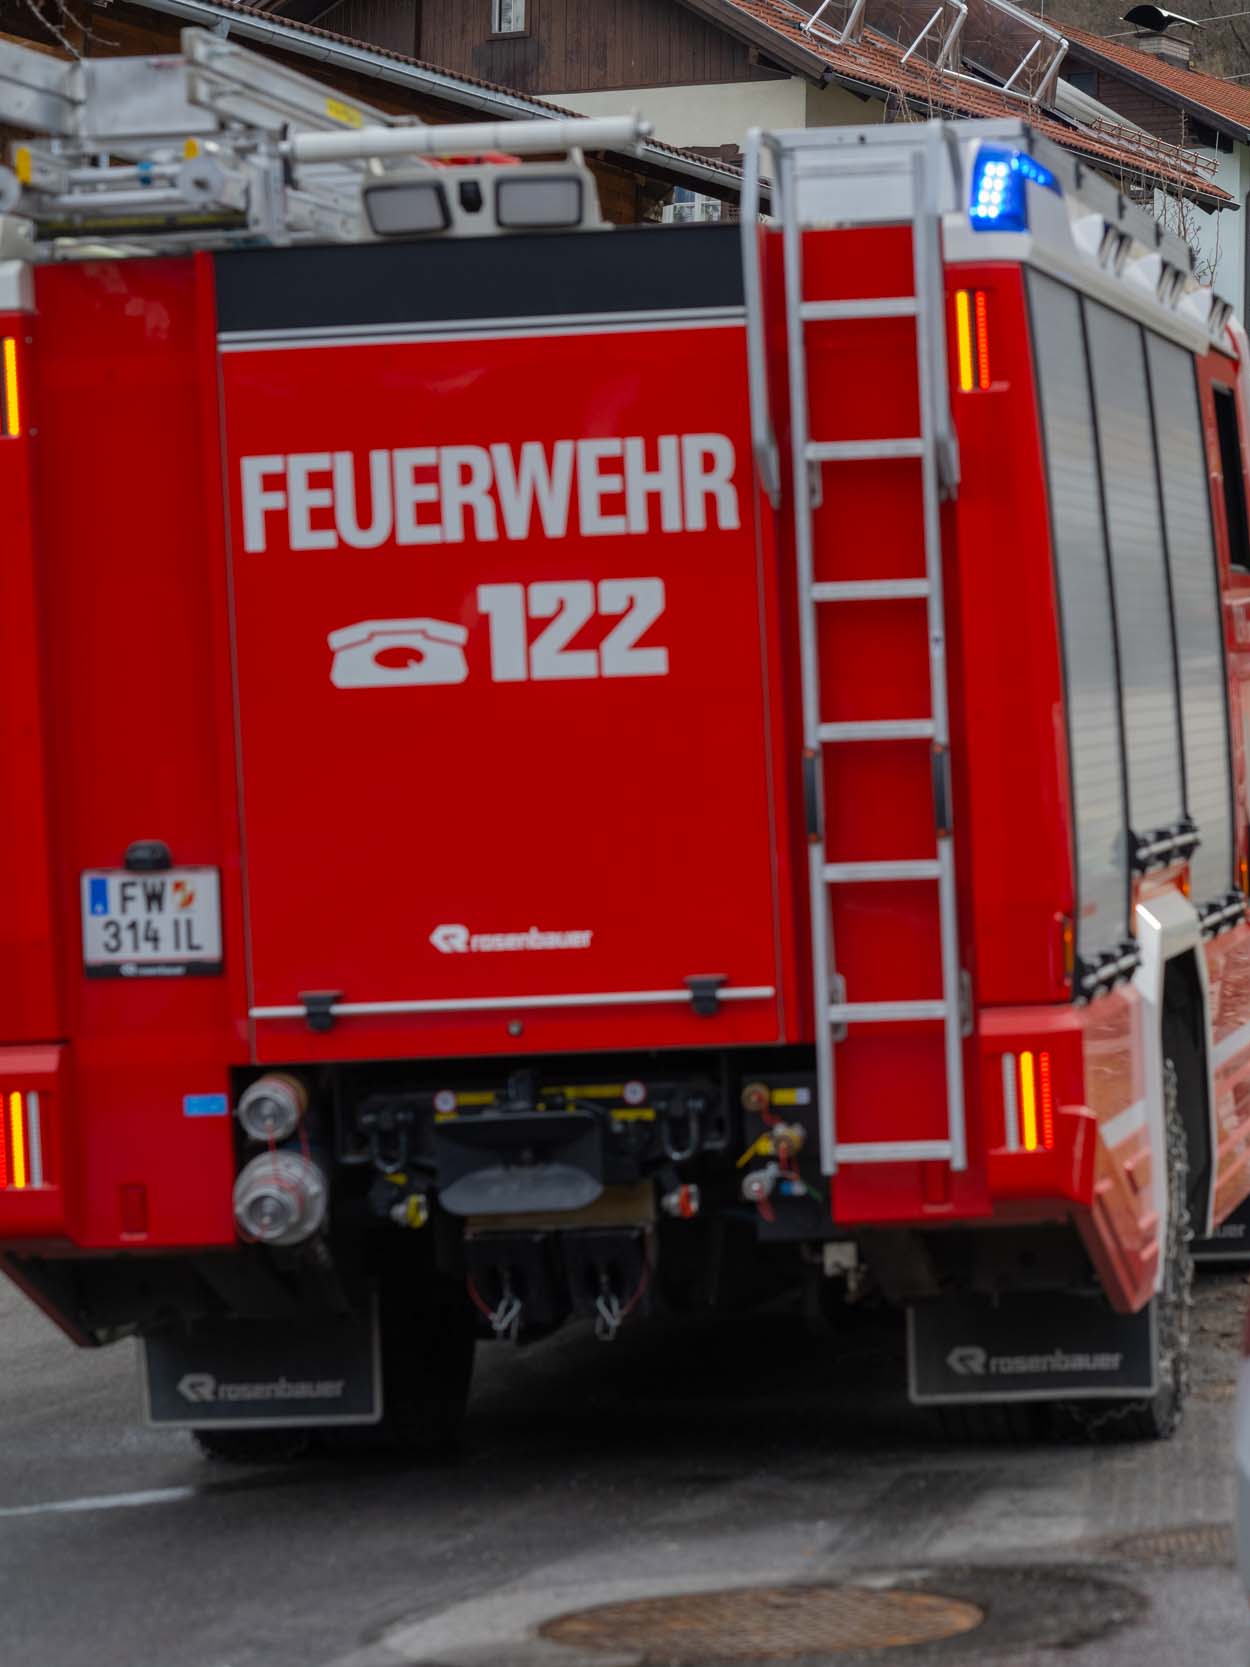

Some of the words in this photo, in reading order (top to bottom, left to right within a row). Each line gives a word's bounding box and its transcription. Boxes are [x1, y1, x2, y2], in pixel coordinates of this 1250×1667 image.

[240, 433, 740, 554] FEUERWEHR
[476, 577, 669, 682] 122
[120, 880, 166, 914] FW
[103, 919, 160, 954] 314
[174, 918, 203, 951] IL
[989, 1349, 1124, 1375] rosenbauer
[218, 1376, 345, 1400] rosenbauer
